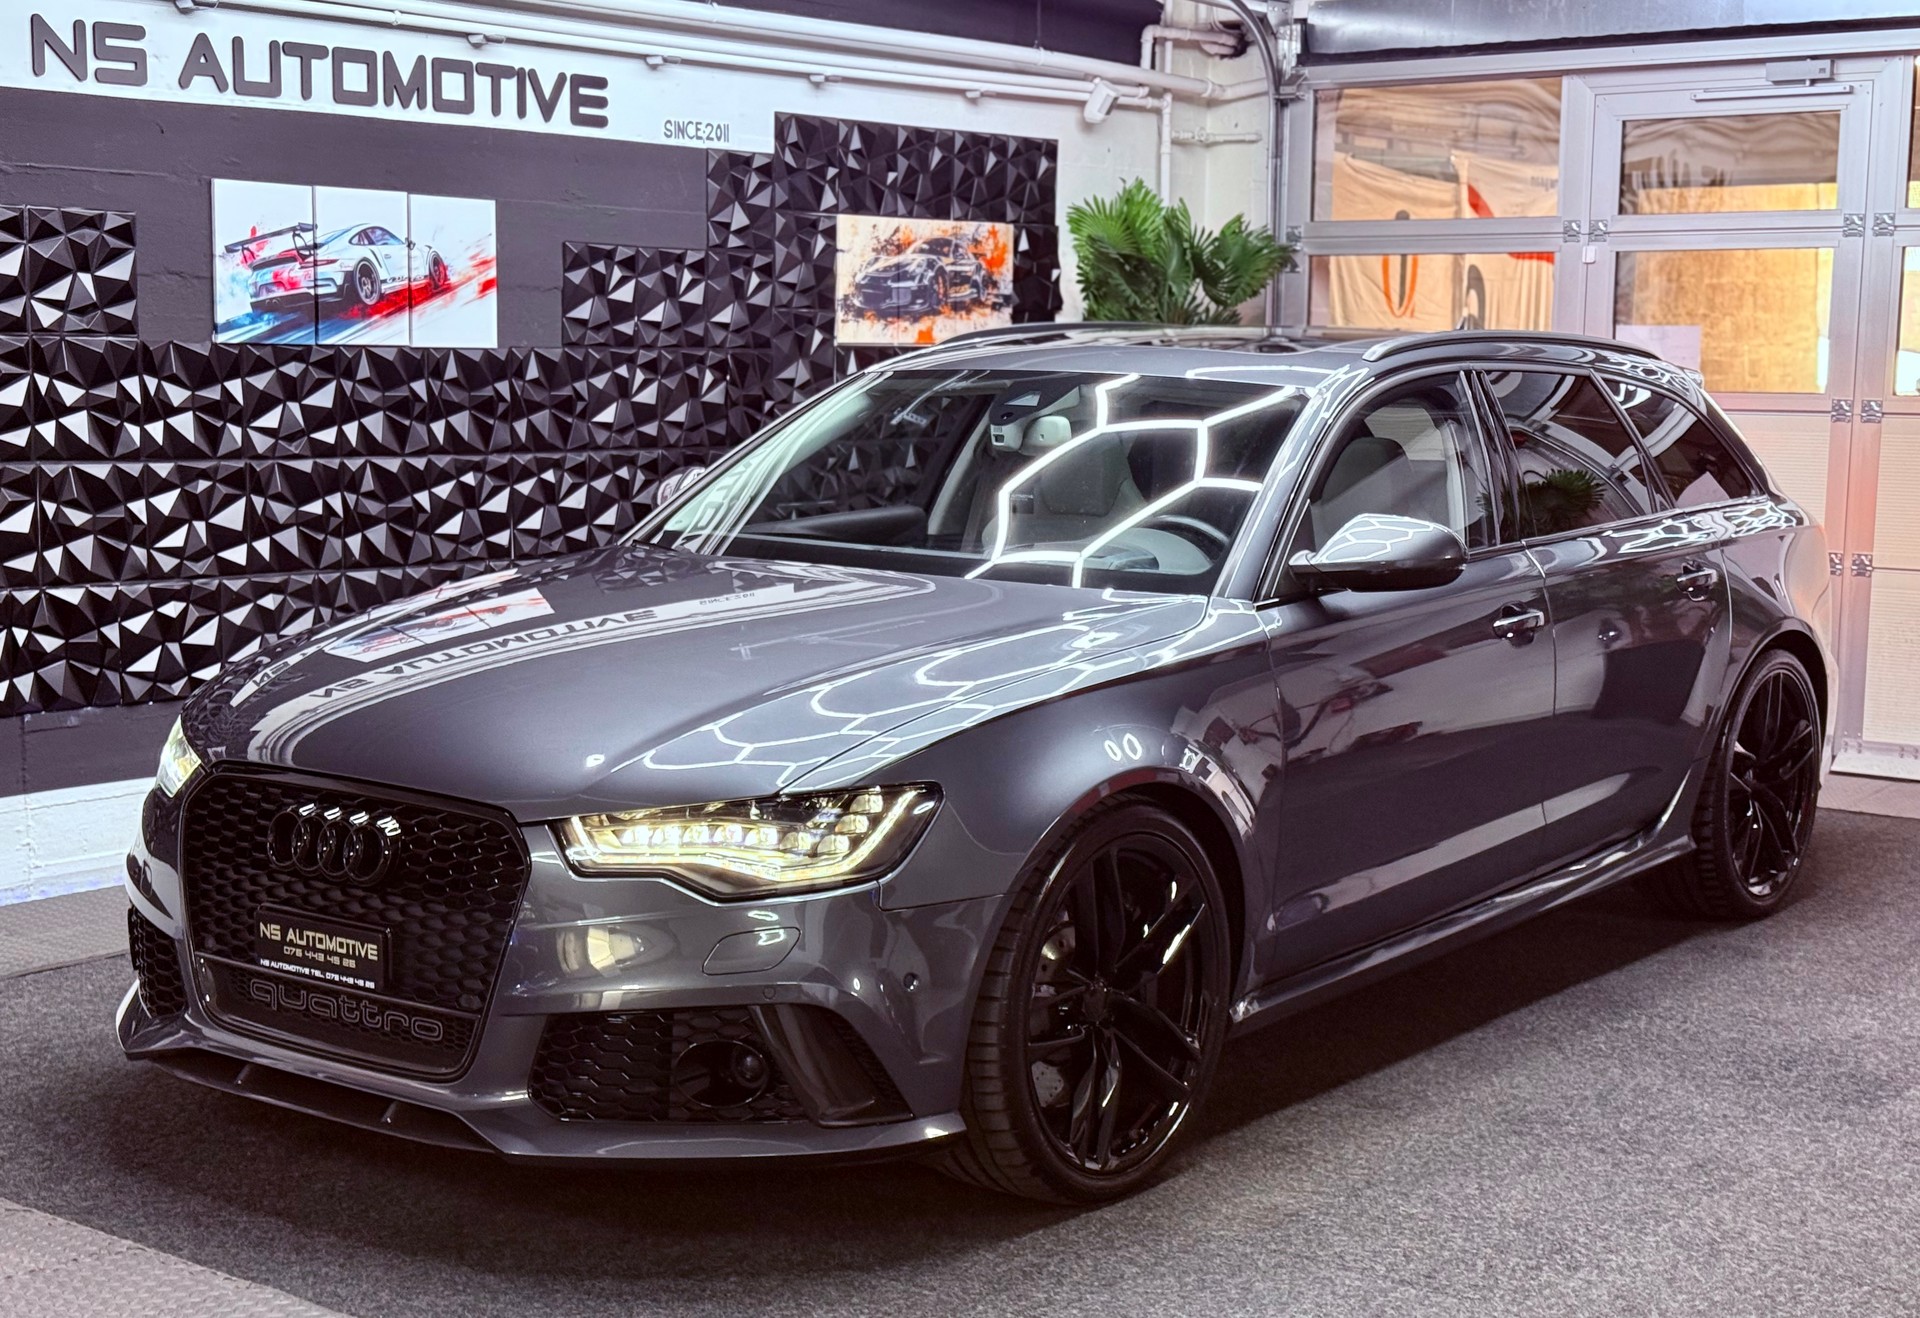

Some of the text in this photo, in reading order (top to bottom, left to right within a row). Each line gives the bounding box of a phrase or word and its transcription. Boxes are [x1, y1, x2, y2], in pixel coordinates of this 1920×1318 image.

[30, 13, 609, 128] NS AUTOMOTIVE
[260, 921, 378, 961] NS AUTOMOTIVE
[270, 960, 310, 975] AUTOMOTIVE
[250, 978, 444, 1041] quattro
